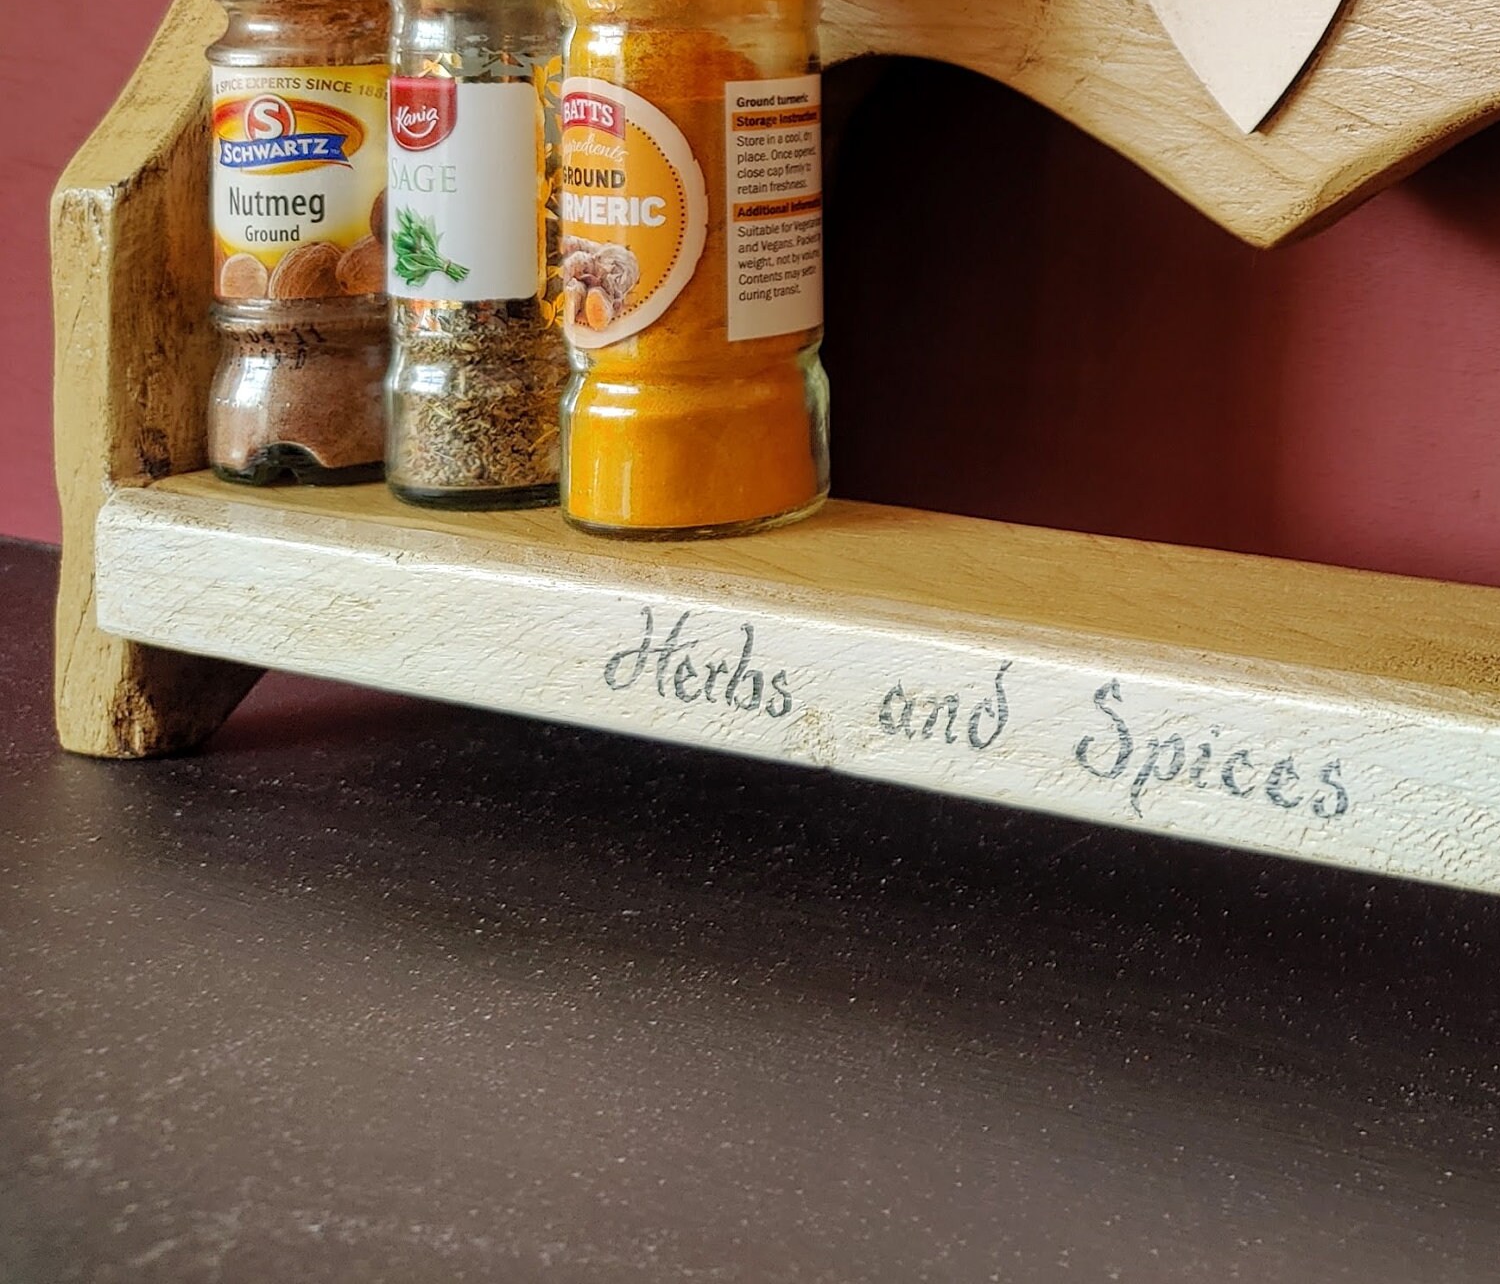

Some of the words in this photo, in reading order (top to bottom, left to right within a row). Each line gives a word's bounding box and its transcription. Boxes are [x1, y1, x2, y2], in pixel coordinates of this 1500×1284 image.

[220, 77, 243, 92] SPICE
[245, 77, 301, 91] EXPERTS
[305, 78, 352, 93] SINCE
[736, 95, 775, 107] Ground
[252, 101, 283, 140] S
[563, 99, 614, 127] BATTS
[395, 105, 440, 138] Kania
[736, 115, 777, 128] Storage
[736, 135, 765, 147] Store
[766, 134, 775, 145] in
[223, 138, 329, 164] SCHWARTZ
[737, 152, 769, 165] place.
[771, 149, 793, 161] Once
[391, 157, 457, 193] SAGE
[737, 167, 765, 179] close
[767, 167, 784, 178] cap
[737, 182, 768, 195] retain
[229, 187, 325, 223] Nutmeg
[562, 191, 666, 227] RMERIC
[737, 202, 789, 217] Additional
[245, 225, 300, 242] Ground
[737, 223, 780, 237] Suitable
[781, 221, 793, 234] for
[738, 242, 759, 254] and
[738, 257, 775, 270] weight,
[776, 254, 791, 265] not
[791, 252, 800, 266] by
[738, 271, 783, 286] Contents
[784, 269, 800, 281] may
[738, 287, 772, 301] during
[603, 604, 793, 718] Herbs
[877, 658, 1013, 751] and
[1075, 676, 1349, 819] Spices
